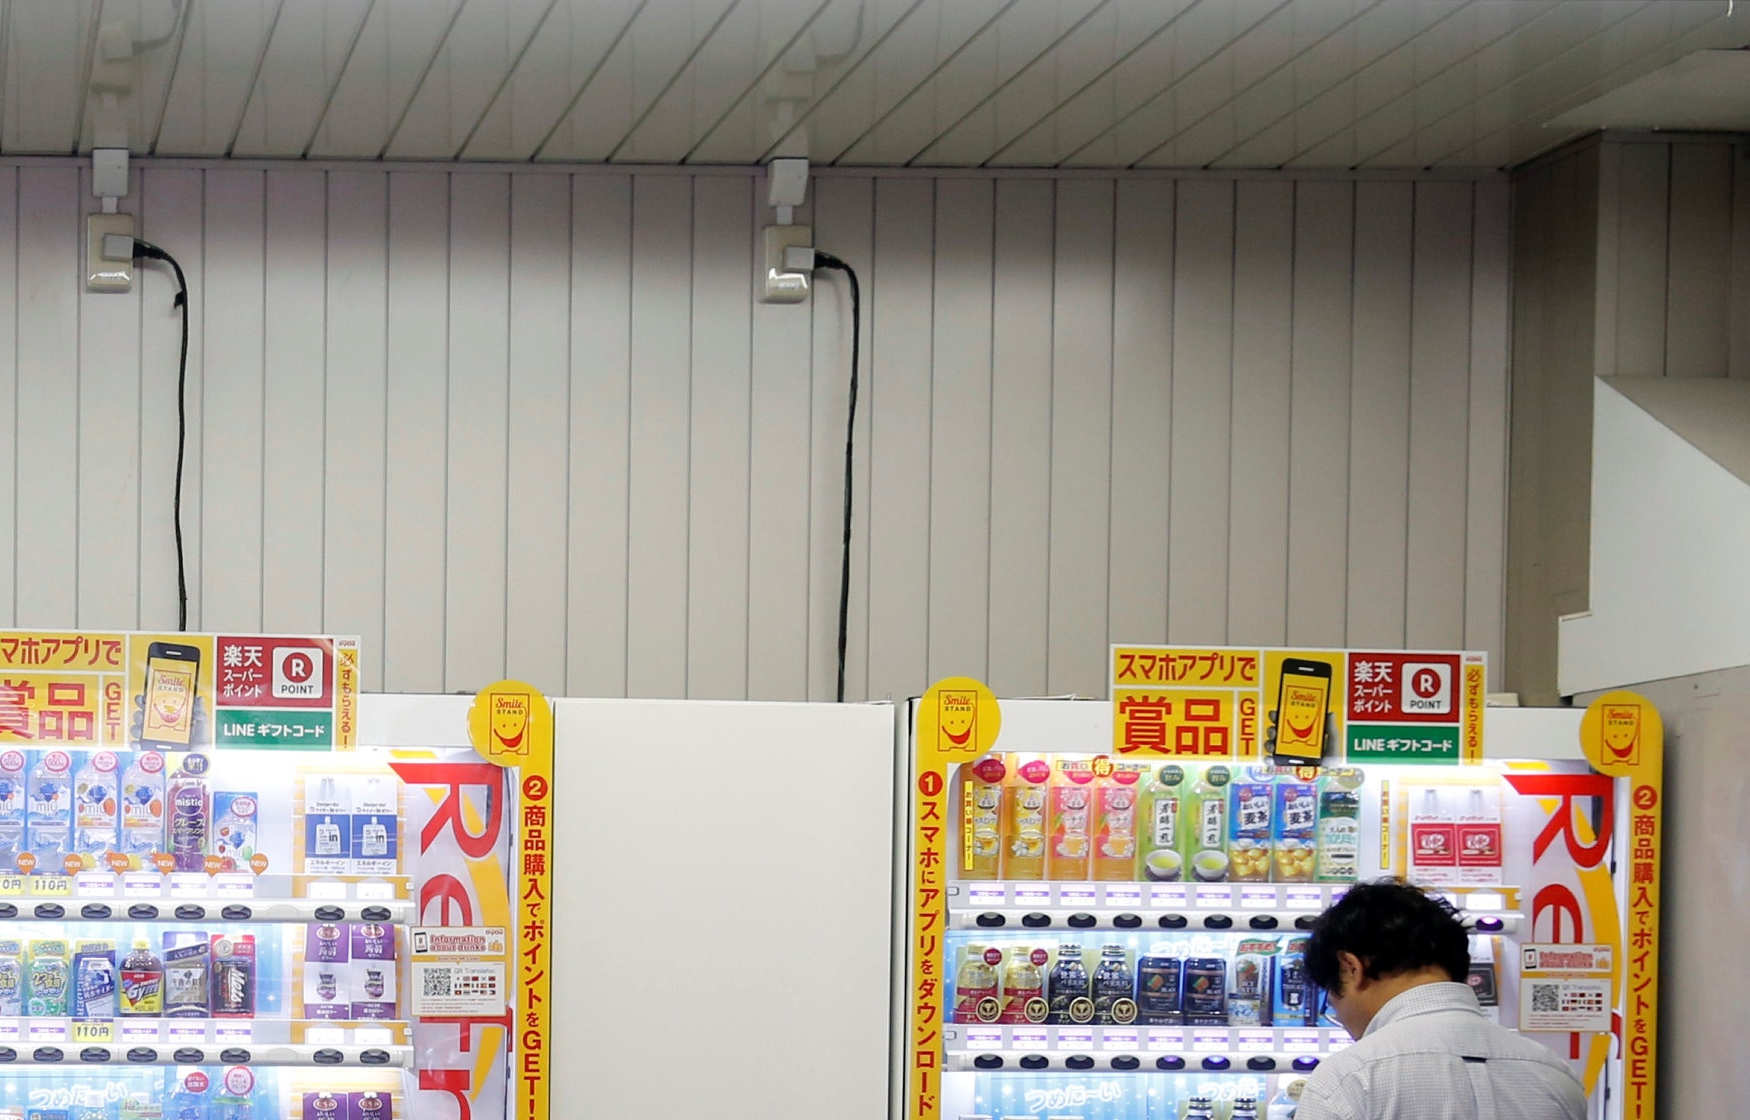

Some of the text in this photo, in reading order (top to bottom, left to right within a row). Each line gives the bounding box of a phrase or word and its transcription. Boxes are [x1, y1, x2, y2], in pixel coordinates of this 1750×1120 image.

[223, 645, 263, 667] 楽天
[1118, 653, 1257, 682] スマホアプリで
[1353, 661, 1393, 683] 楽天
[157, 673, 185, 687] Smile
[223, 669, 263, 682] スーパー
[158, 685, 186, 693] STAND
[223, 683, 263, 698] ポイント
[280, 684, 315, 696] POINT
[1290, 689, 1317, 702] Smile
[1353, 685, 1393, 698] スーパー
[496, 697, 524, 709] Smile
[943, 694, 972, 706] Smile
[1291, 700, 1317, 708] STAND
[1353, 699, 1393, 713] ポイント
[1409, 700, 1443, 710] POINT
[105, 682, 122, 741] GET
[944, 705, 972, 713] STAND
[1605, 708, 1635, 720] Smile
[223, 723, 326, 739] LINE ギフトコード
[1118, 695, 1230, 755] 賞品
[1239, 698, 1256, 756] GET
[1353, 738, 1453, 752] LINE ギフトコード
[1244, 810, 1270, 825] 麦茶
[1288, 810, 1315, 825] 麦茶
[17, 858, 35, 867] NEW
[64, 860, 82, 869] NEW
[111, 858, 129, 867] NEW
[157, 859, 174, 868] NEW
[205, 861, 222, 869] NEW
[250, 859, 268, 868] NEW
[34, 879, 67, 891] 110円
[915, 801, 941, 1116] スマホにアプリをダウンロード
[77, 1026, 110, 1037] 110円
